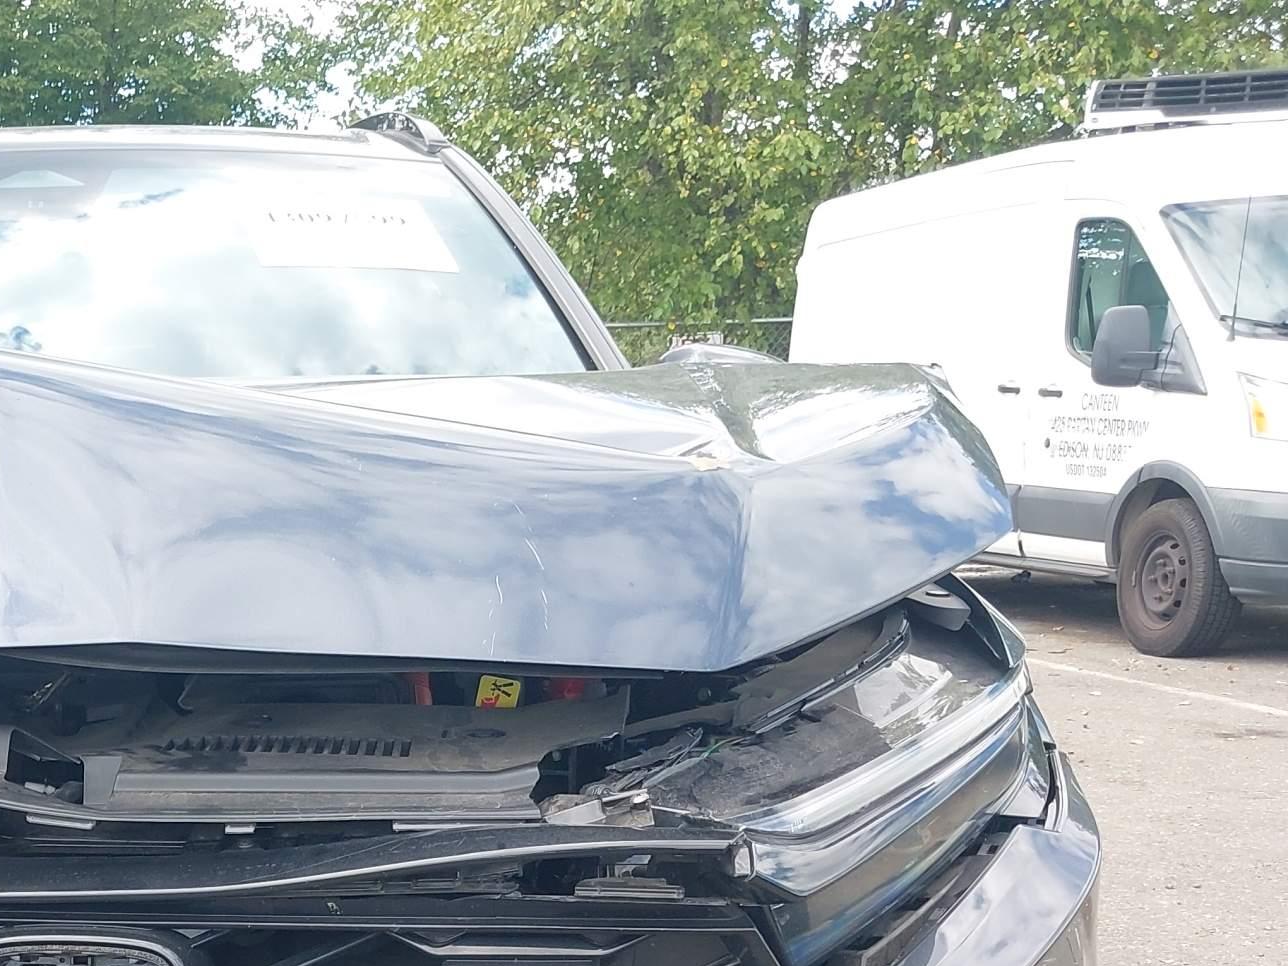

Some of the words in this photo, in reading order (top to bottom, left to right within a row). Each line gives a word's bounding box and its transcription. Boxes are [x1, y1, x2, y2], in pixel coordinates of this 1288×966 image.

[1081, 392, 1120, 411] CANTEEN
[1096, 417, 1126, 436] CENTER
[1065, 463, 1085, 476] USDOT
